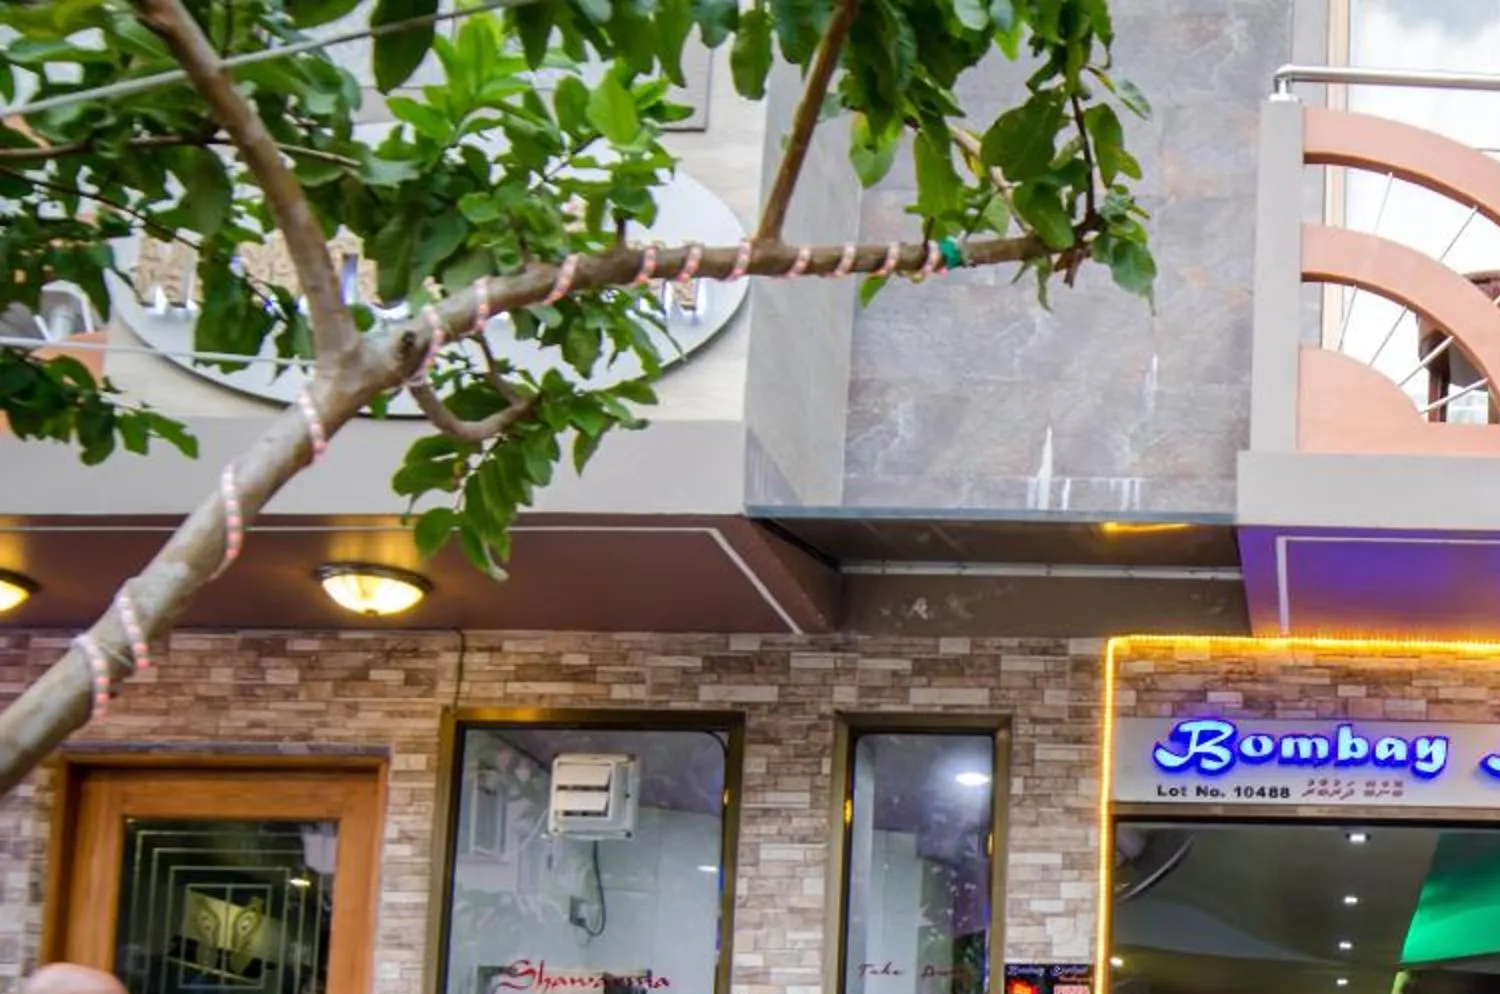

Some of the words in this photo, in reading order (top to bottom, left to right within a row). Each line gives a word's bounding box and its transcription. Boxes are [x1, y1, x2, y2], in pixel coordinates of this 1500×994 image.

[1153, 719, 1449, 779] Bombay
[1156, 784, 1188, 798] Lot
[1195, 785, 1226, 799] No.
[1232, 785, 1291, 800] 10488
[858, 961, 906, 978] Take
